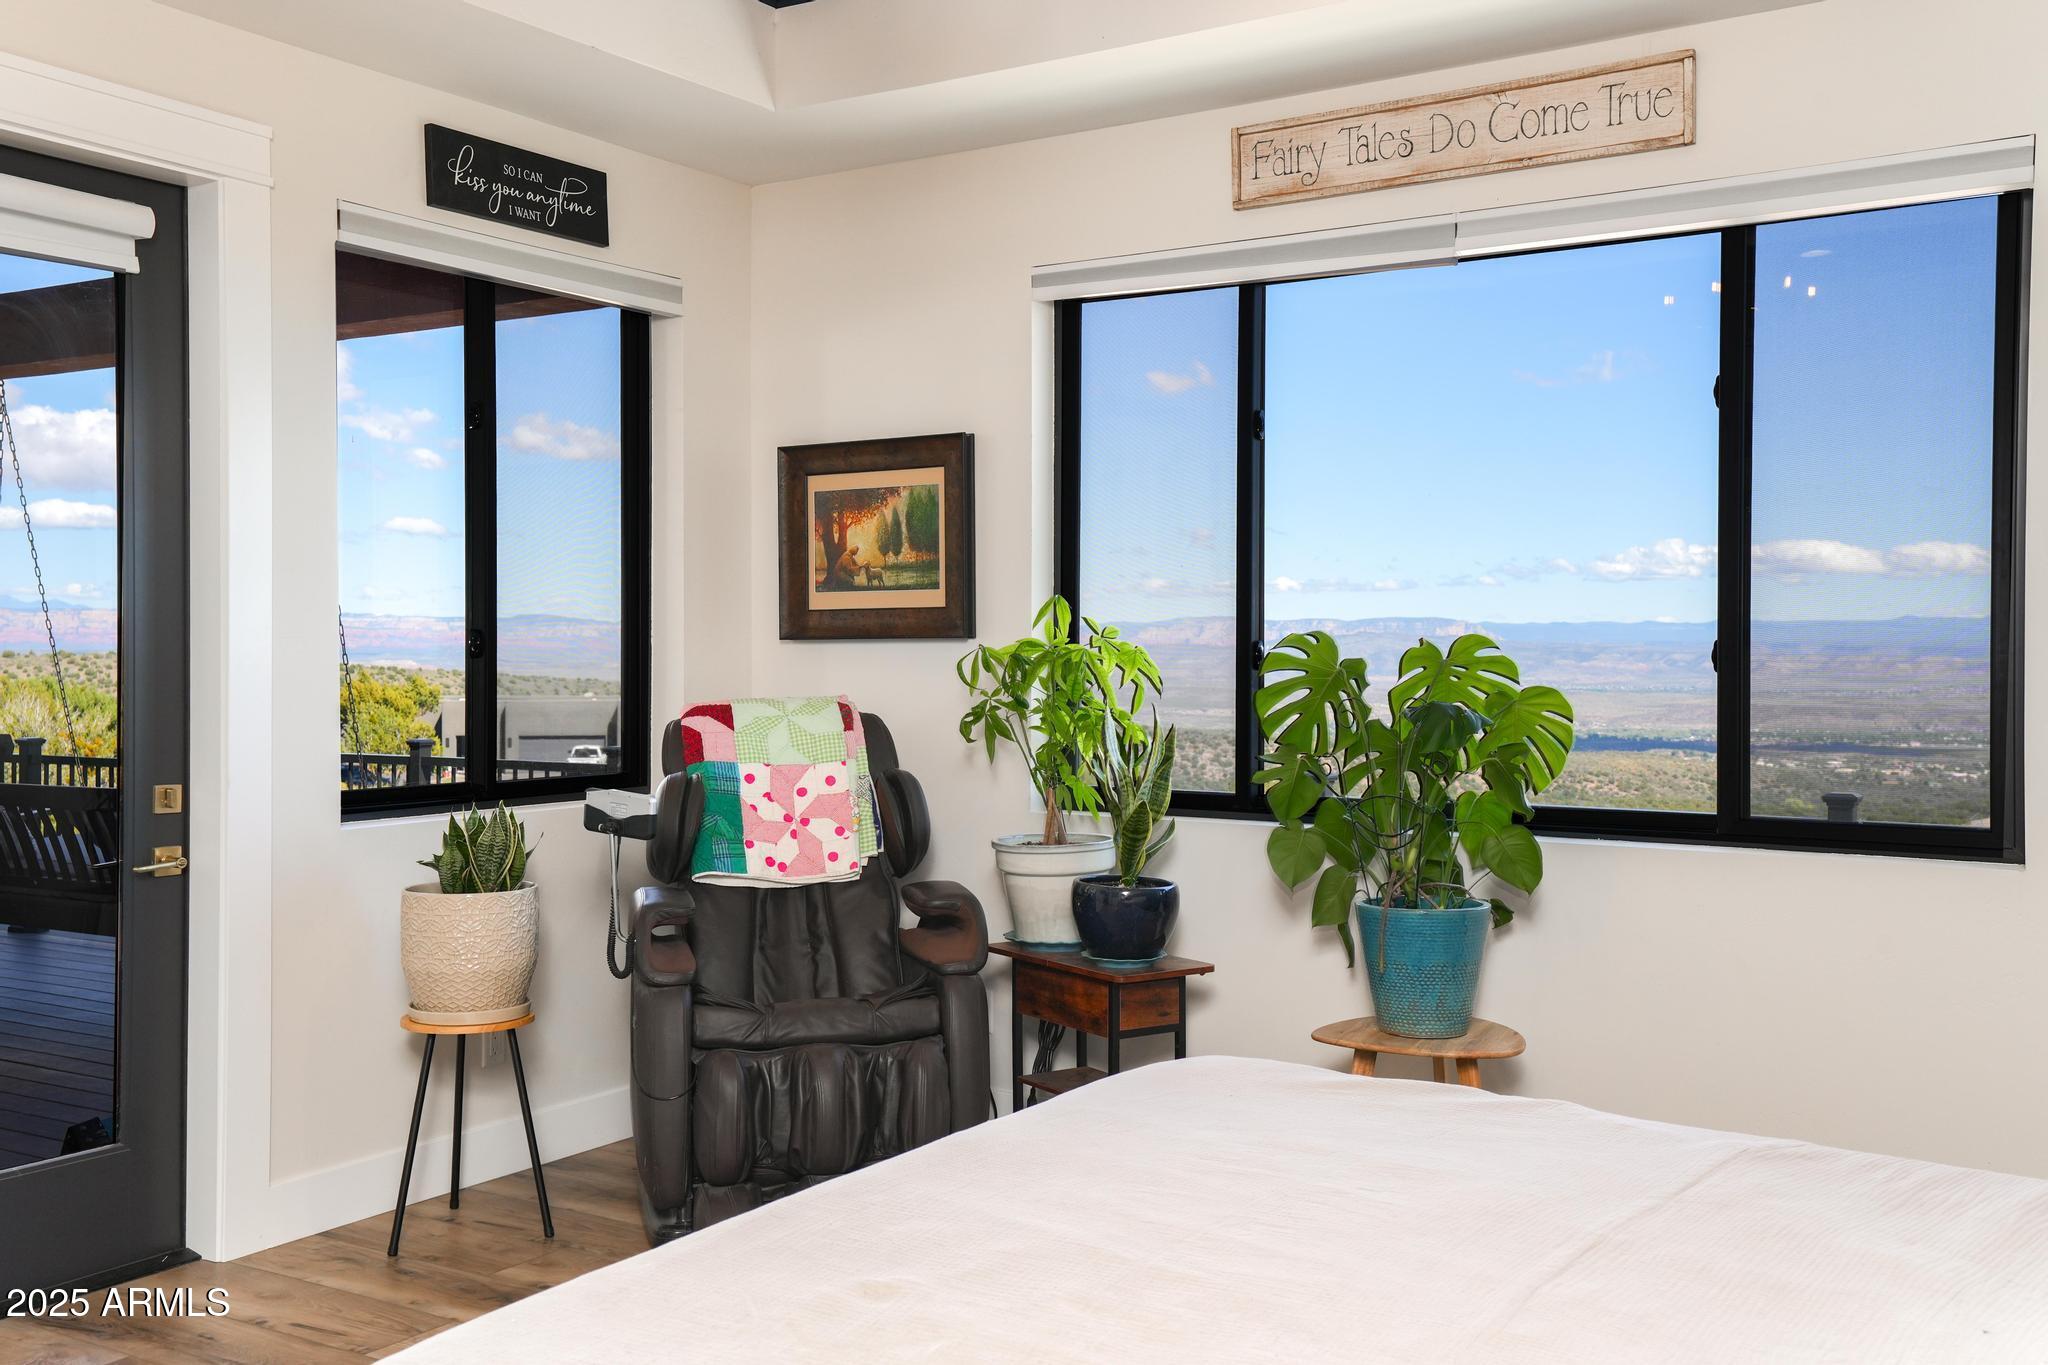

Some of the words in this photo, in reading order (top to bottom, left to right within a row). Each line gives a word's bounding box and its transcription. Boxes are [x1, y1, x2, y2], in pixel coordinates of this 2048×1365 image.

[1250, 138, 1327, 186] Fairy
[1338, 123, 1414, 167] Tales
[1428, 112, 1476, 154] Do
[1488, 101, 1590, 143] Come
[1599, 81, 1675, 127] True
[447, 145, 488, 192] kiss
[488, 182, 524, 214] you
[526, 177, 597, 227] anytime
[503, 164, 515, 177] SO
[517, 167, 522, 178] I
[524, 169, 543, 183] CAN
[508, 205, 513, 216] I
[514, 206, 542, 222] WANT
